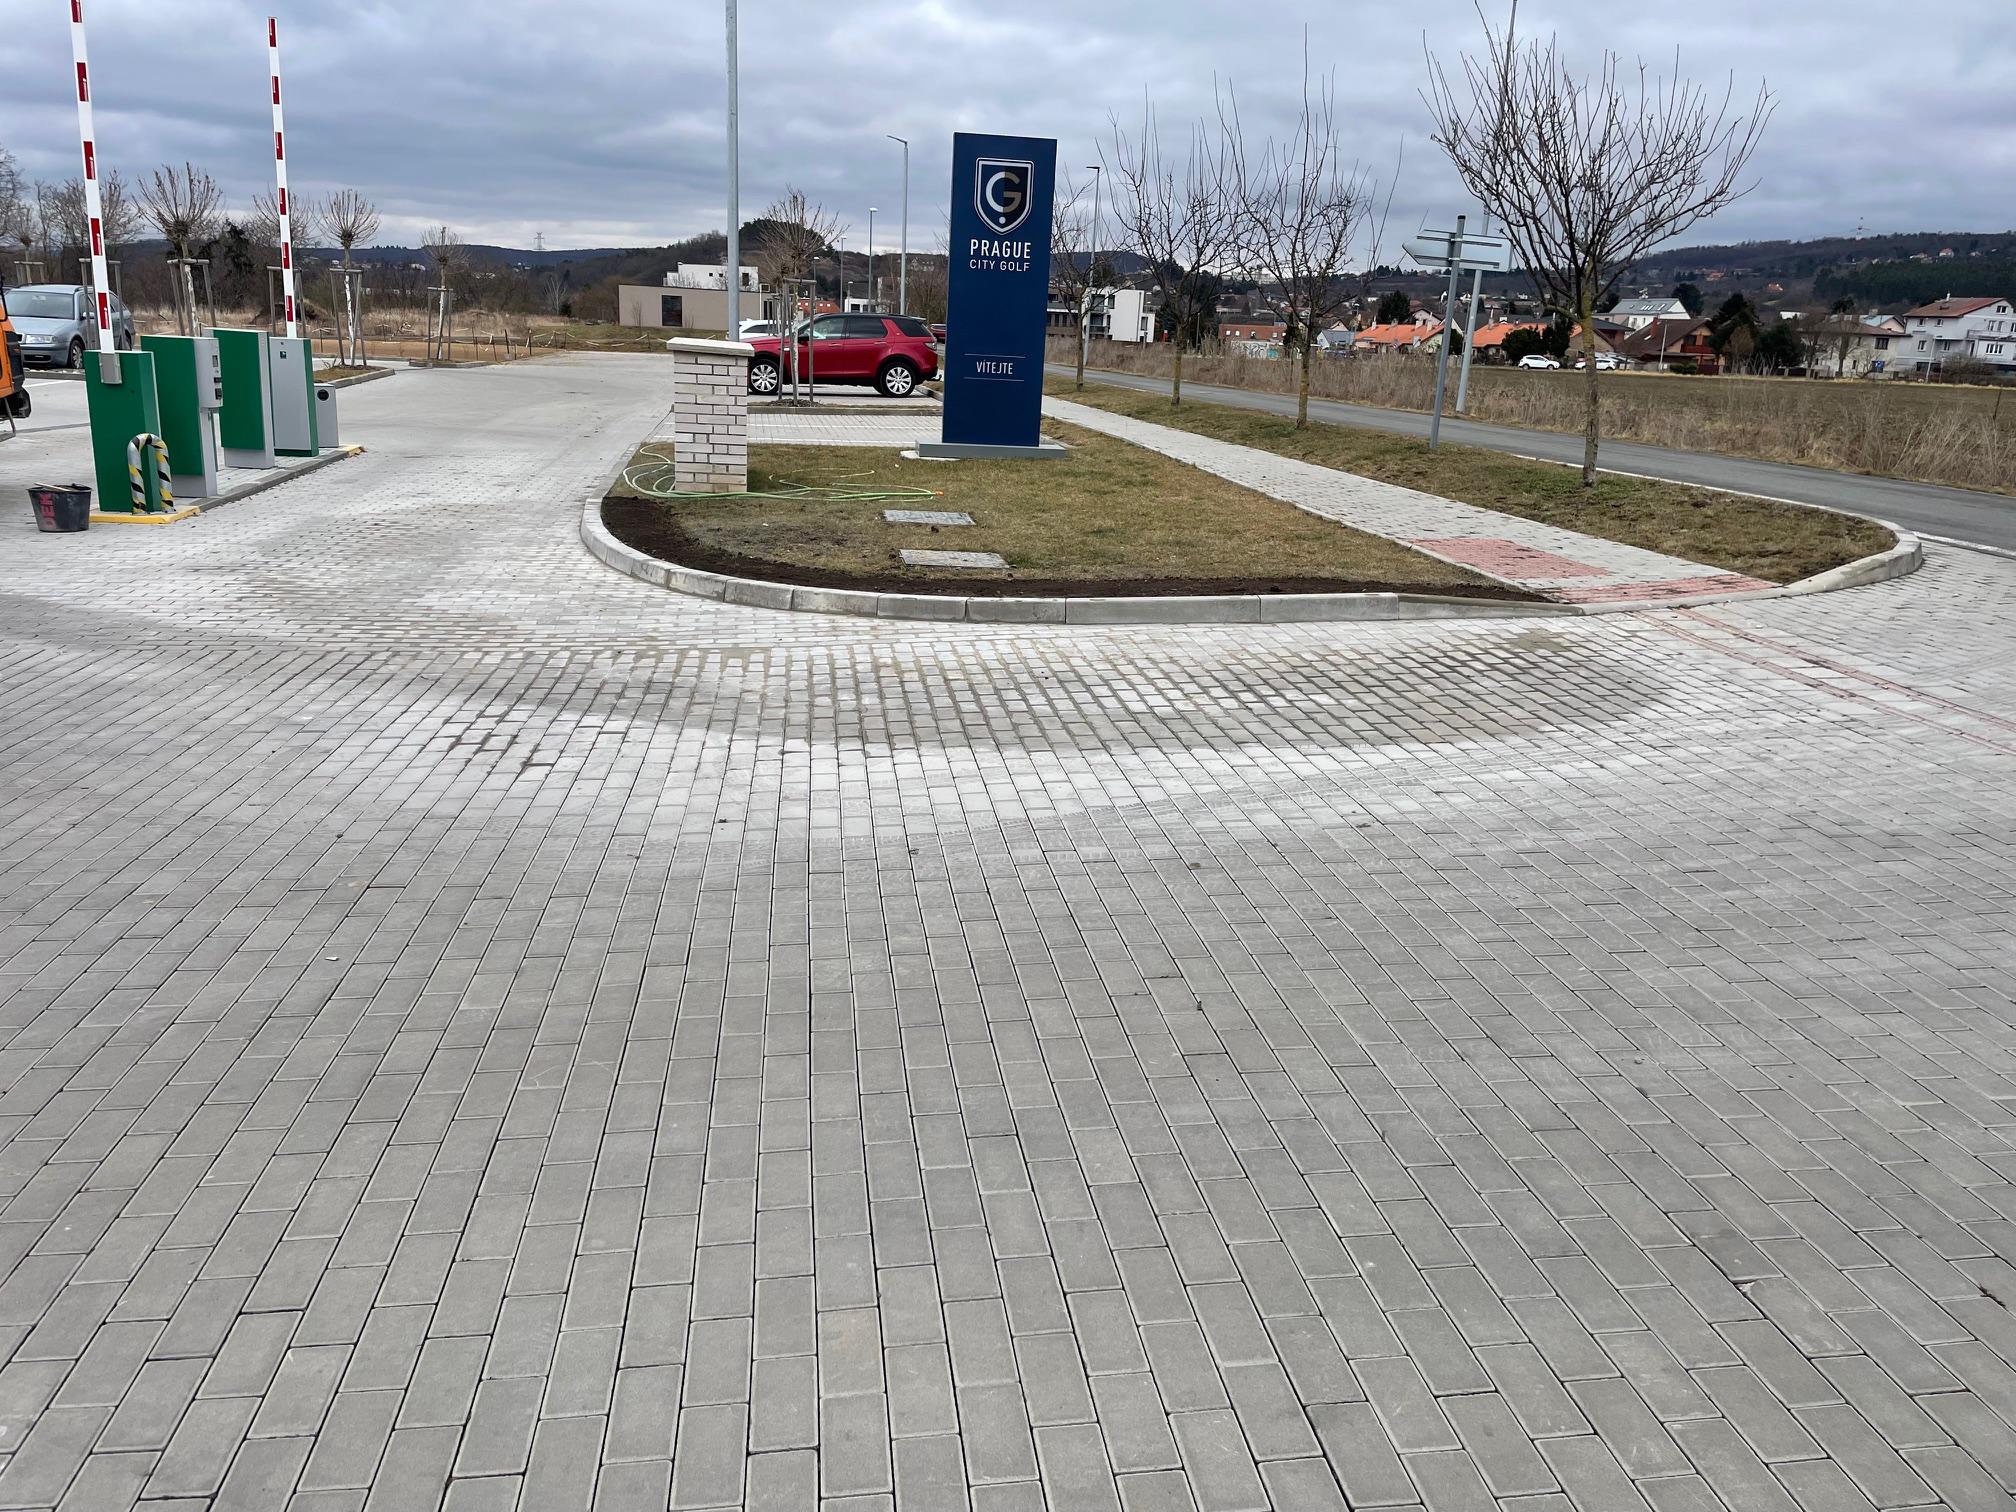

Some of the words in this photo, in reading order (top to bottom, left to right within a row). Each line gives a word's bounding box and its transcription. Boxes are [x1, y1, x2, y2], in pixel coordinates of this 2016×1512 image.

[970, 239, 1031, 259] PRAGUE
[969, 259, 996, 270] CITY
[1000, 260, 1030, 272] GOLF
[976, 359, 1014, 375] VÍTEJTE
